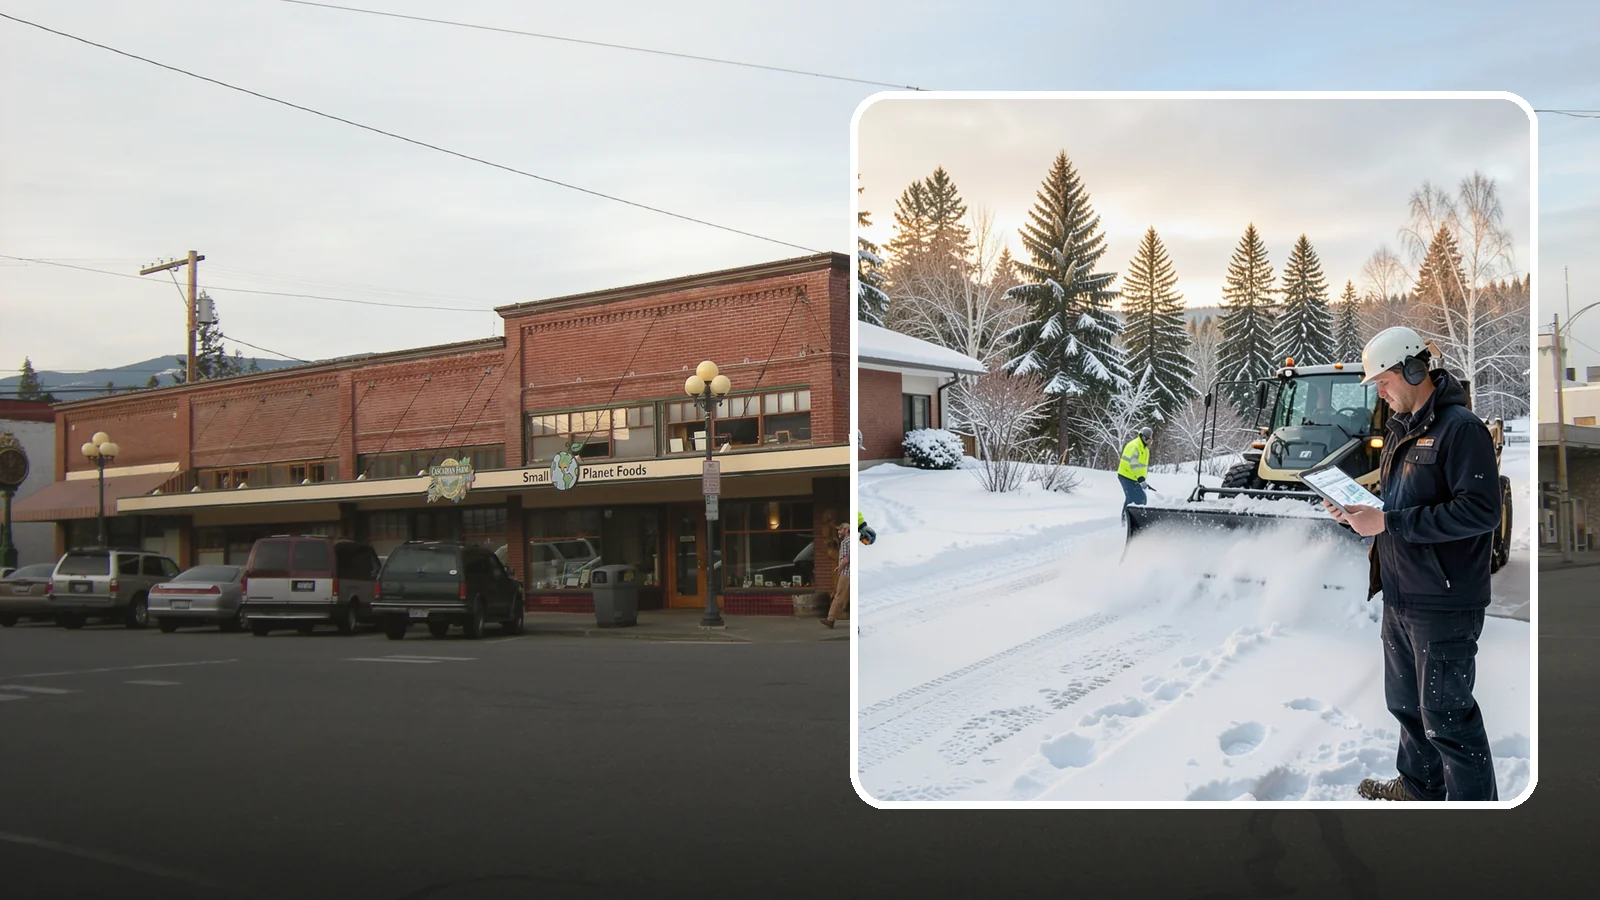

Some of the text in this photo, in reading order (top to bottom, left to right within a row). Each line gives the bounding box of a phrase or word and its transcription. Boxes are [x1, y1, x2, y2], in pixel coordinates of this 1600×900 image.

[523, 465, 647, 483] Small Planet Foods
